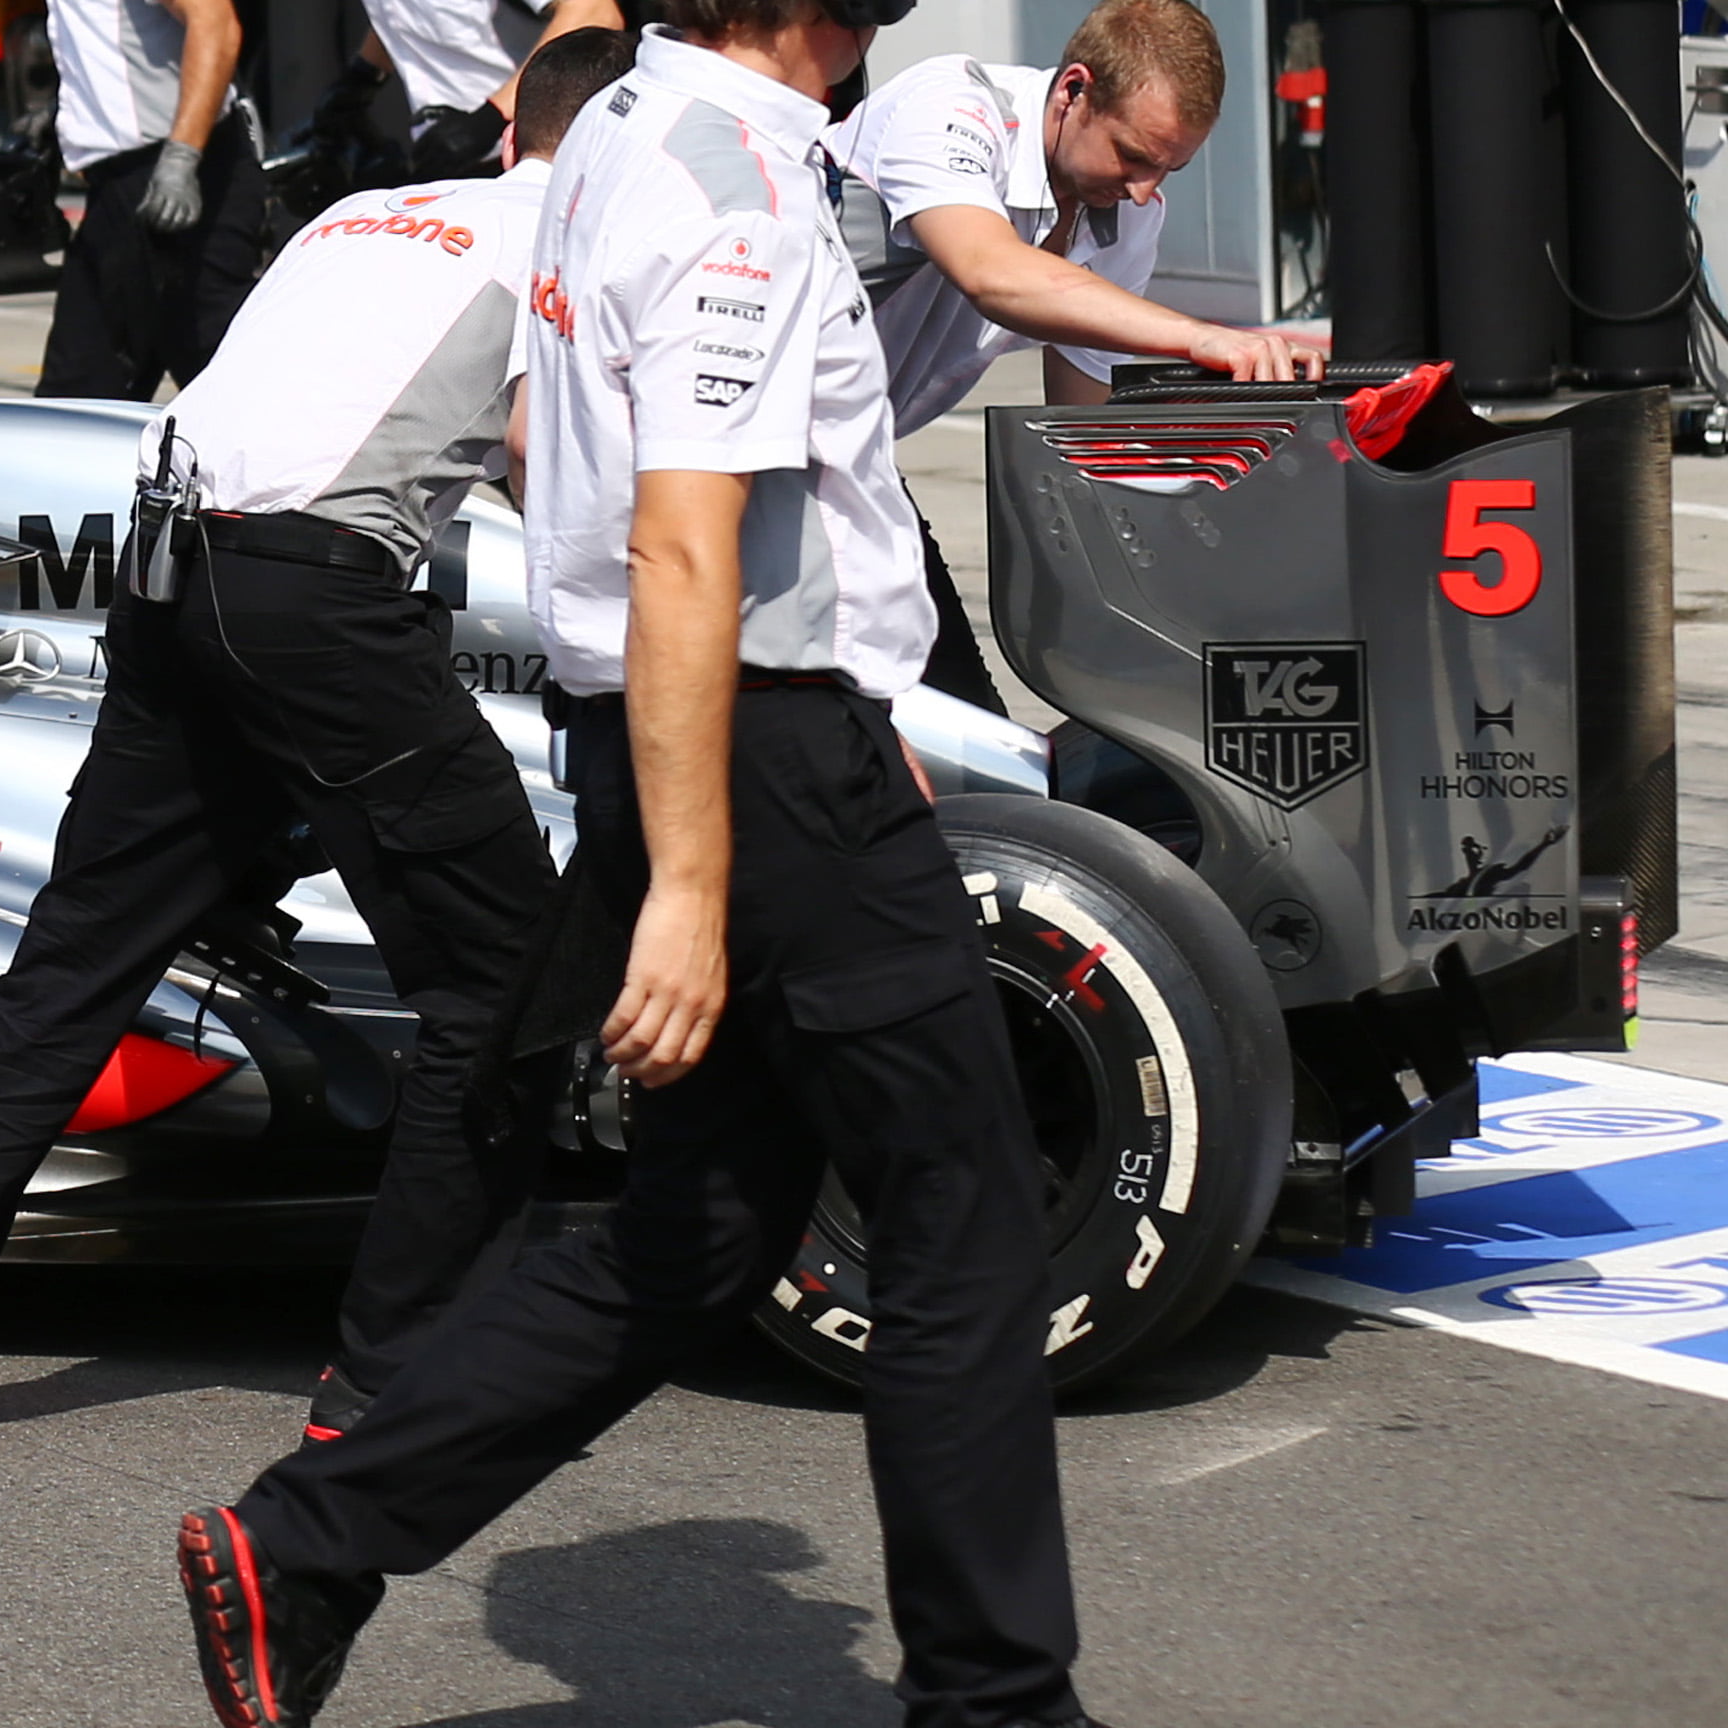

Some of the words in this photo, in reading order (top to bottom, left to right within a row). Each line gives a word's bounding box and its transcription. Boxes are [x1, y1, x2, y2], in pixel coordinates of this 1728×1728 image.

[701, 259, 772, 282] vodafone
[697, 296, 765, 323] PIRELLI
[694, 339, 754, 360] Lucozade
[696, 377, 743, 404] SAP
[1439, 480, 1541, 616] 5
[1234, 656, 1339, 717] TAG
[1221, 731, 1353, 793] HEUER
[1455, 752, 1535, 770] HILTON
[1420, 775, 1569, 799] HHONORS
[1407, 905, 1568, 930] AkzoNobel
[1113, 1148, 1154, 1204] 513
[1126, 1215, 1166, 1290] P
